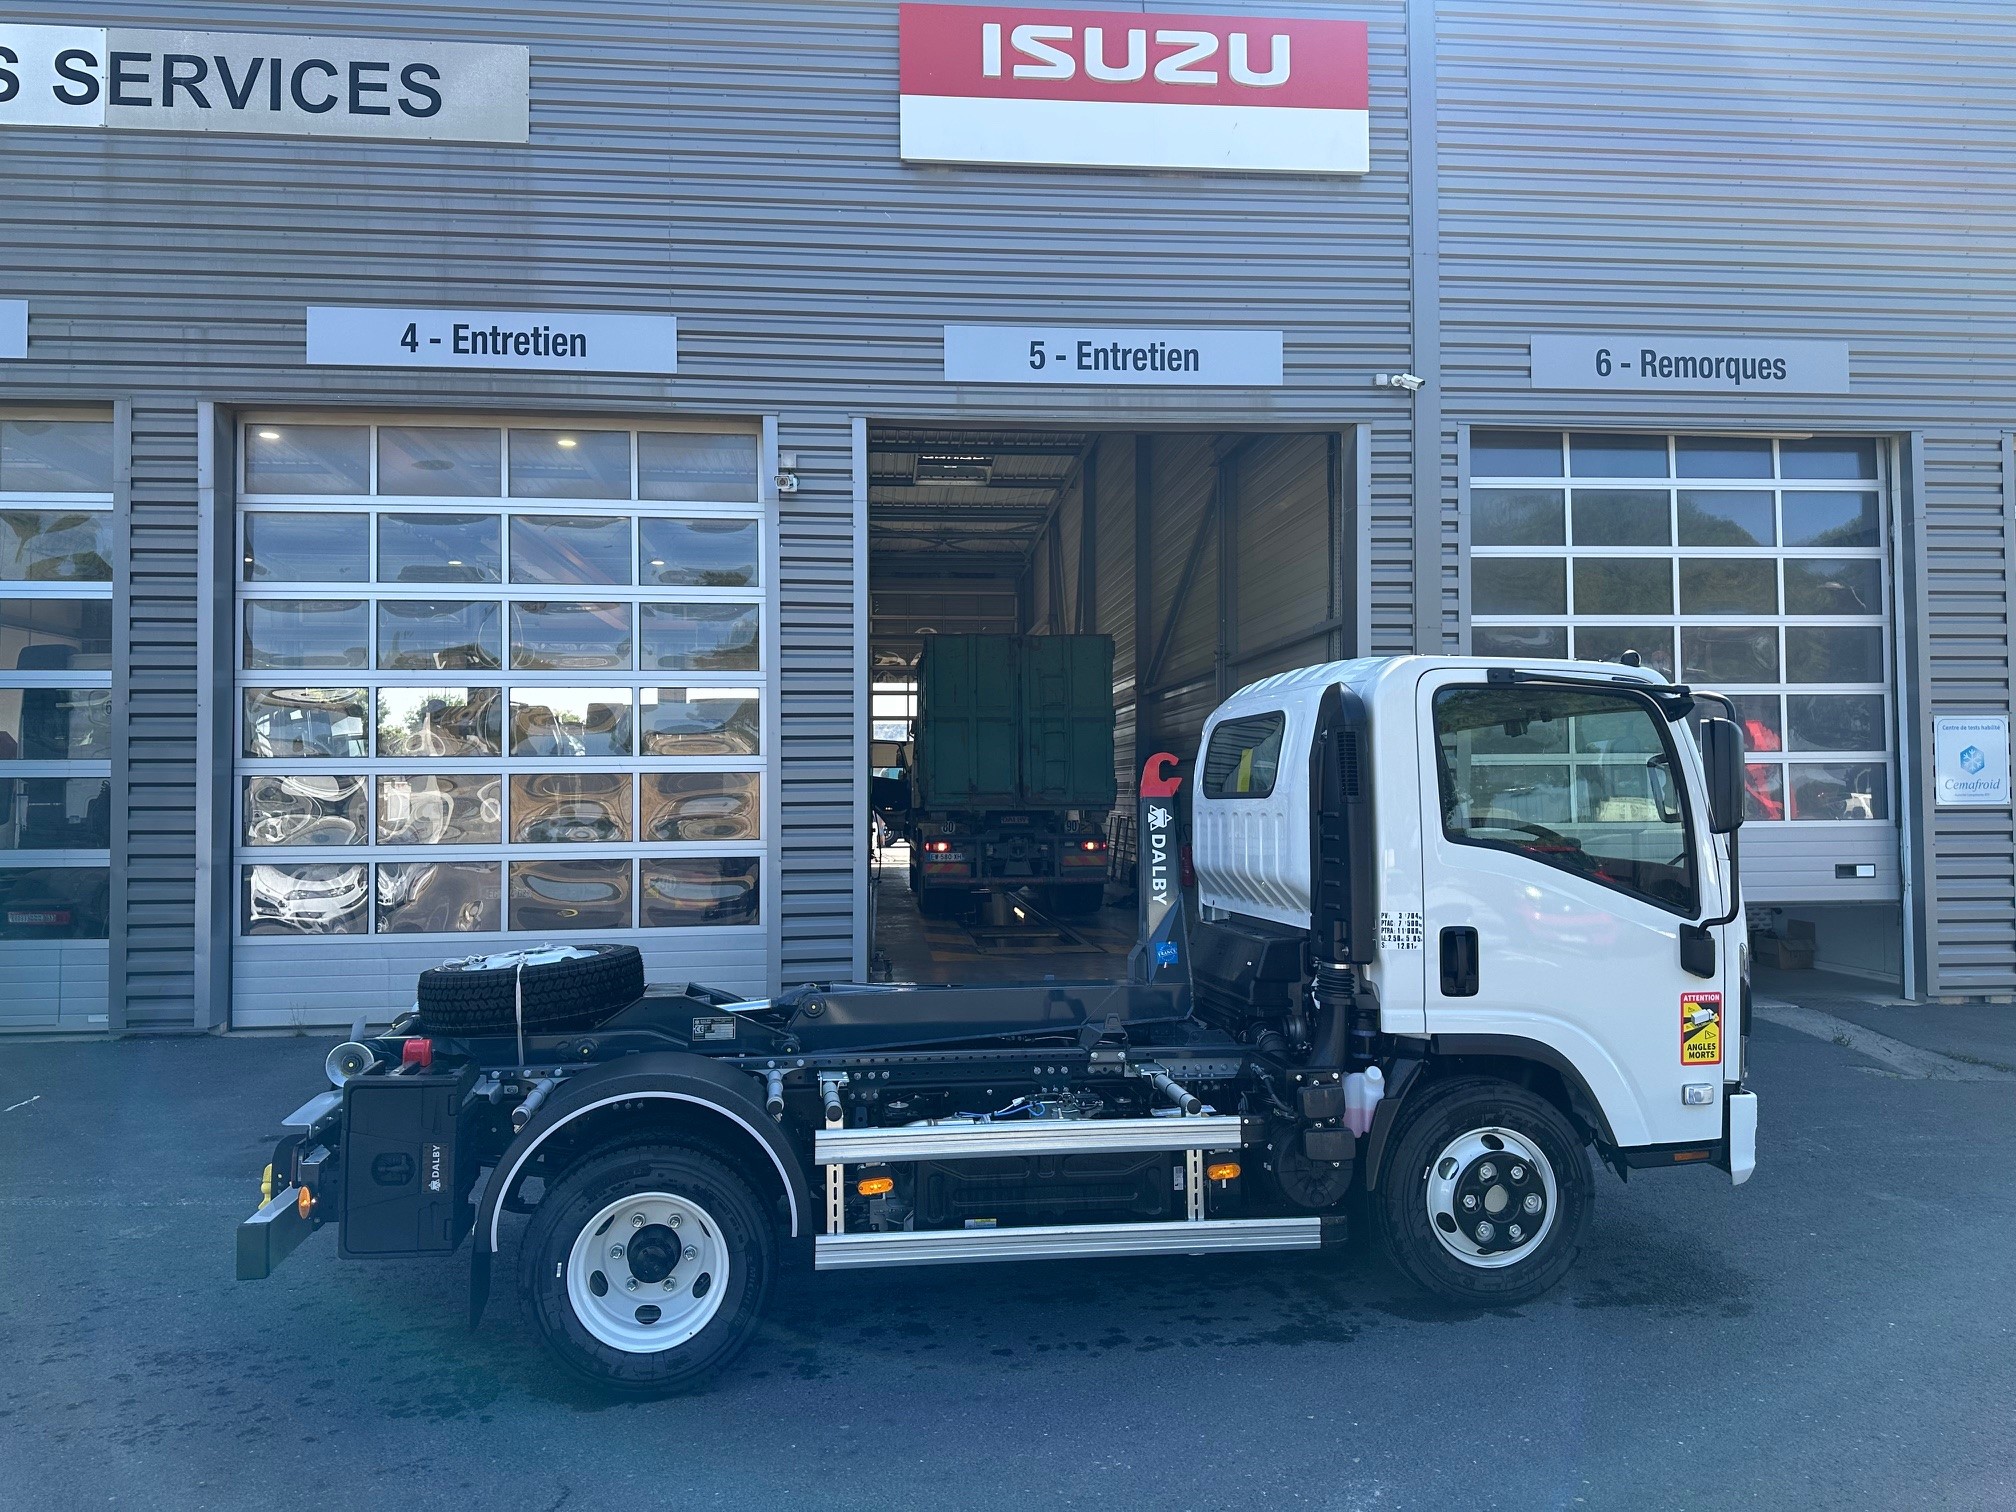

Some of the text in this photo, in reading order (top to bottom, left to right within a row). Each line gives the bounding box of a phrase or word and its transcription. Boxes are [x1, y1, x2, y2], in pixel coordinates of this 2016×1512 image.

[982, 22, 1292, 88] ISUZU
[52, 48, 443, 118] SERVICES
[400, 323, 419, 353] 4
[452, 323, 588, 358] Entretien
[1029, 341, 1046, 370] 5
[1077, 341, 1200, 372] Entretien
[1595, 348, 1612, 377] 6
[1640, 349, 1787, 385] Remorques
[1944, 778, 2001, 792] Cemafroid
[1066, 820, 1077, 832] 90
[1151, 834, 1168, 906] DALBY
[1683, 994, 1720, 1002] ATTENTION
[1687, 1043, 1716, 1051] ANGLES
[1688, 1051, 1715, 1059] MORTS
[431, 1145, 441, 1178] DALBY
